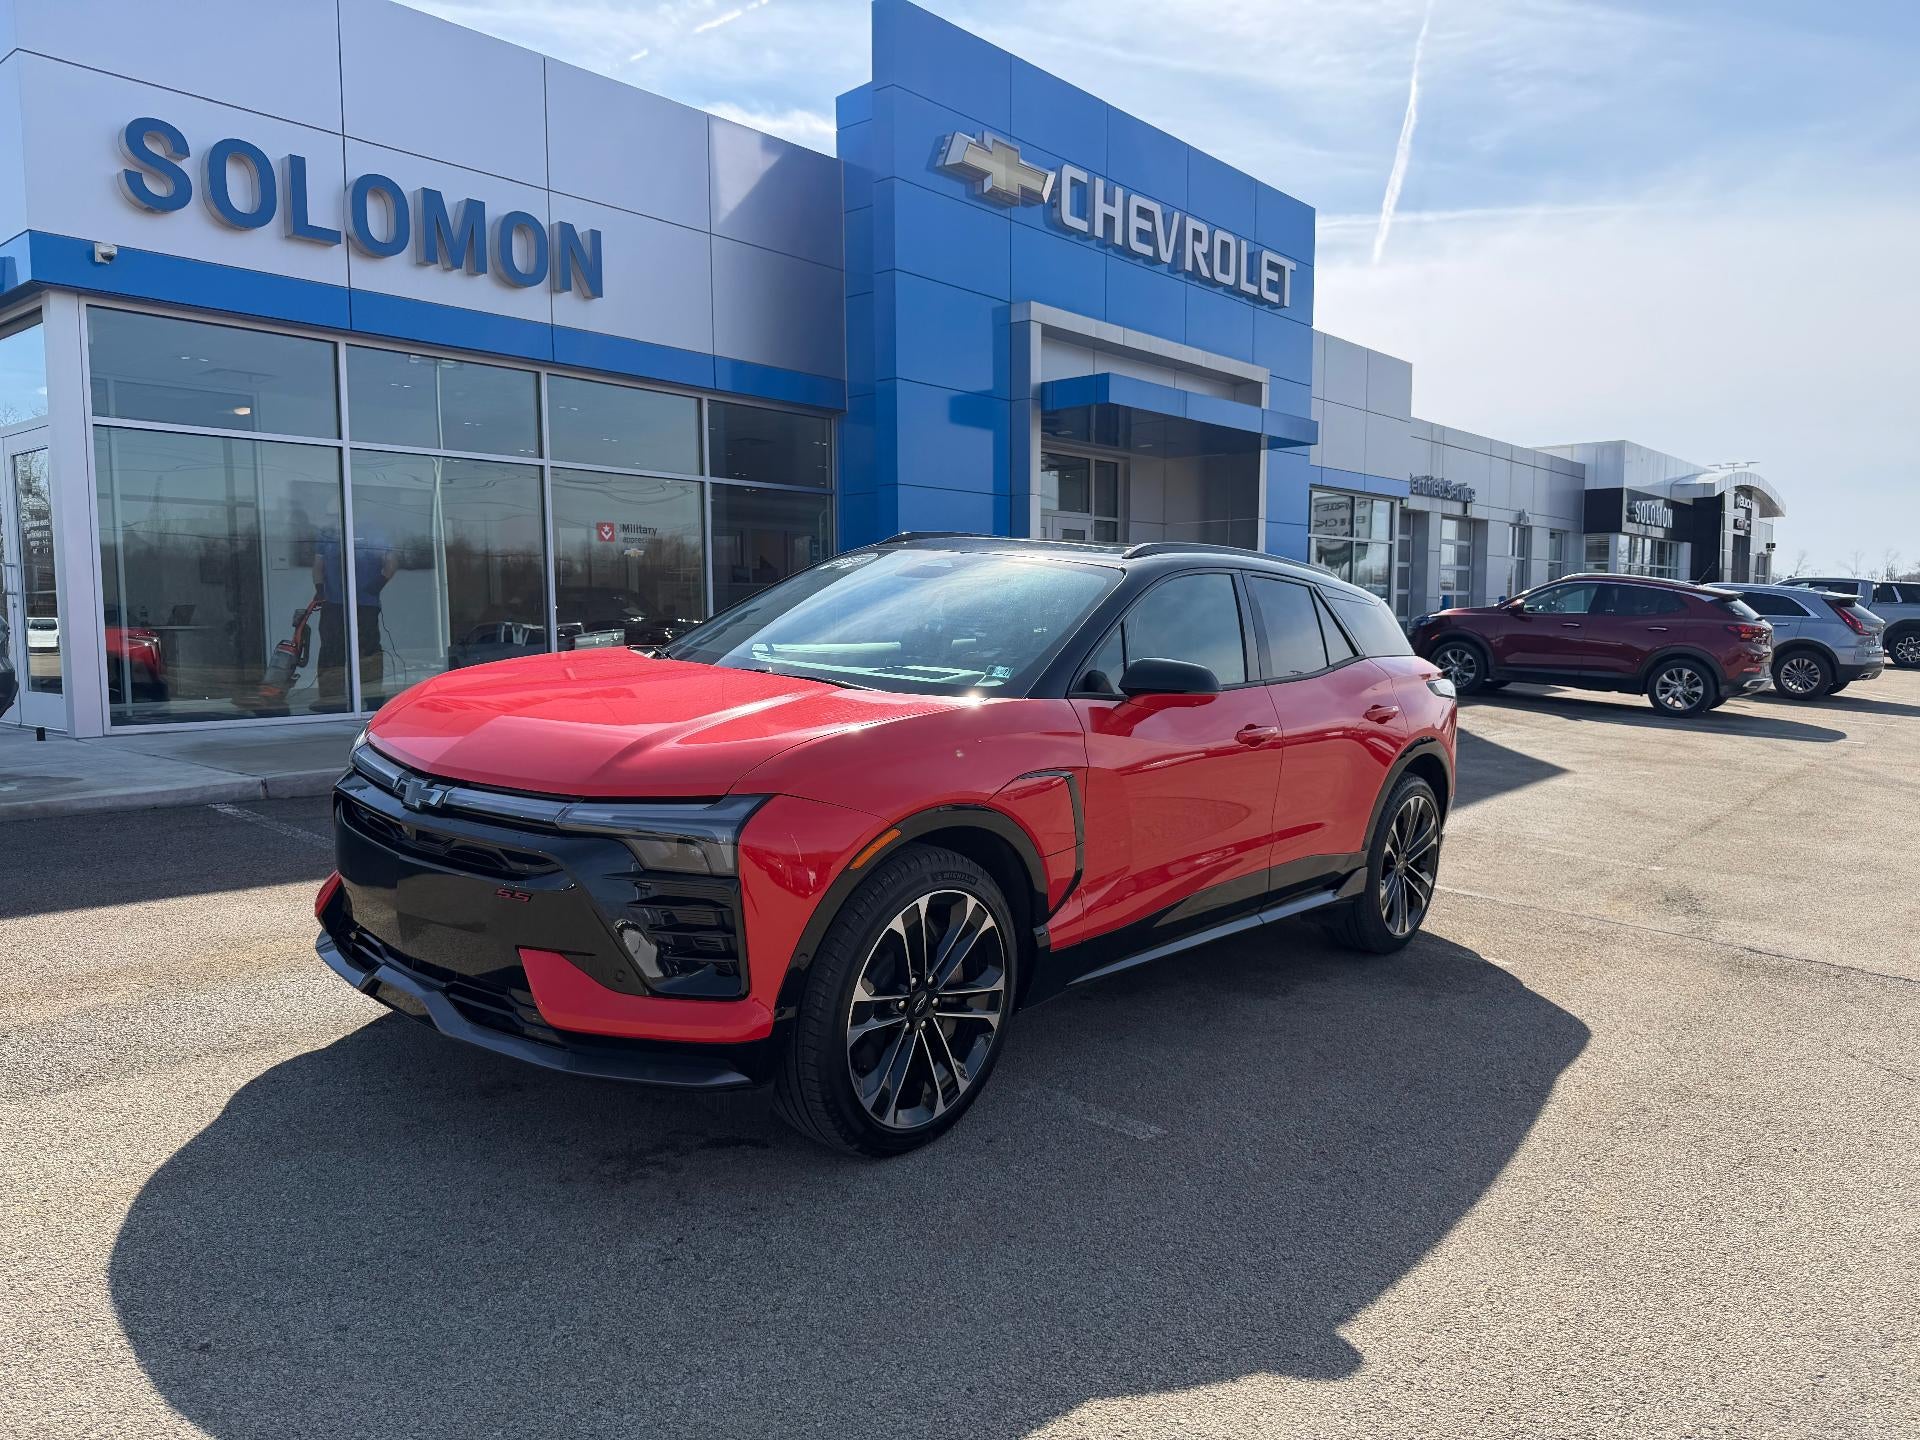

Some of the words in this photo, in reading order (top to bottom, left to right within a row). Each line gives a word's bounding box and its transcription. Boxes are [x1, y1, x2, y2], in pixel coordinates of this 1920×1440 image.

[118, 117, 603, 298] SOLOMON
[1058, 164, 1297, 308] CHEVROLET
[1409, 475, 1444, 497] ertified
[1446, 480, 1476, 503] Service
[1635, 501, 1673, 528] SOLOMON
[622, 523, 658, 537] Military
[496, 887, 531, 903] SS
